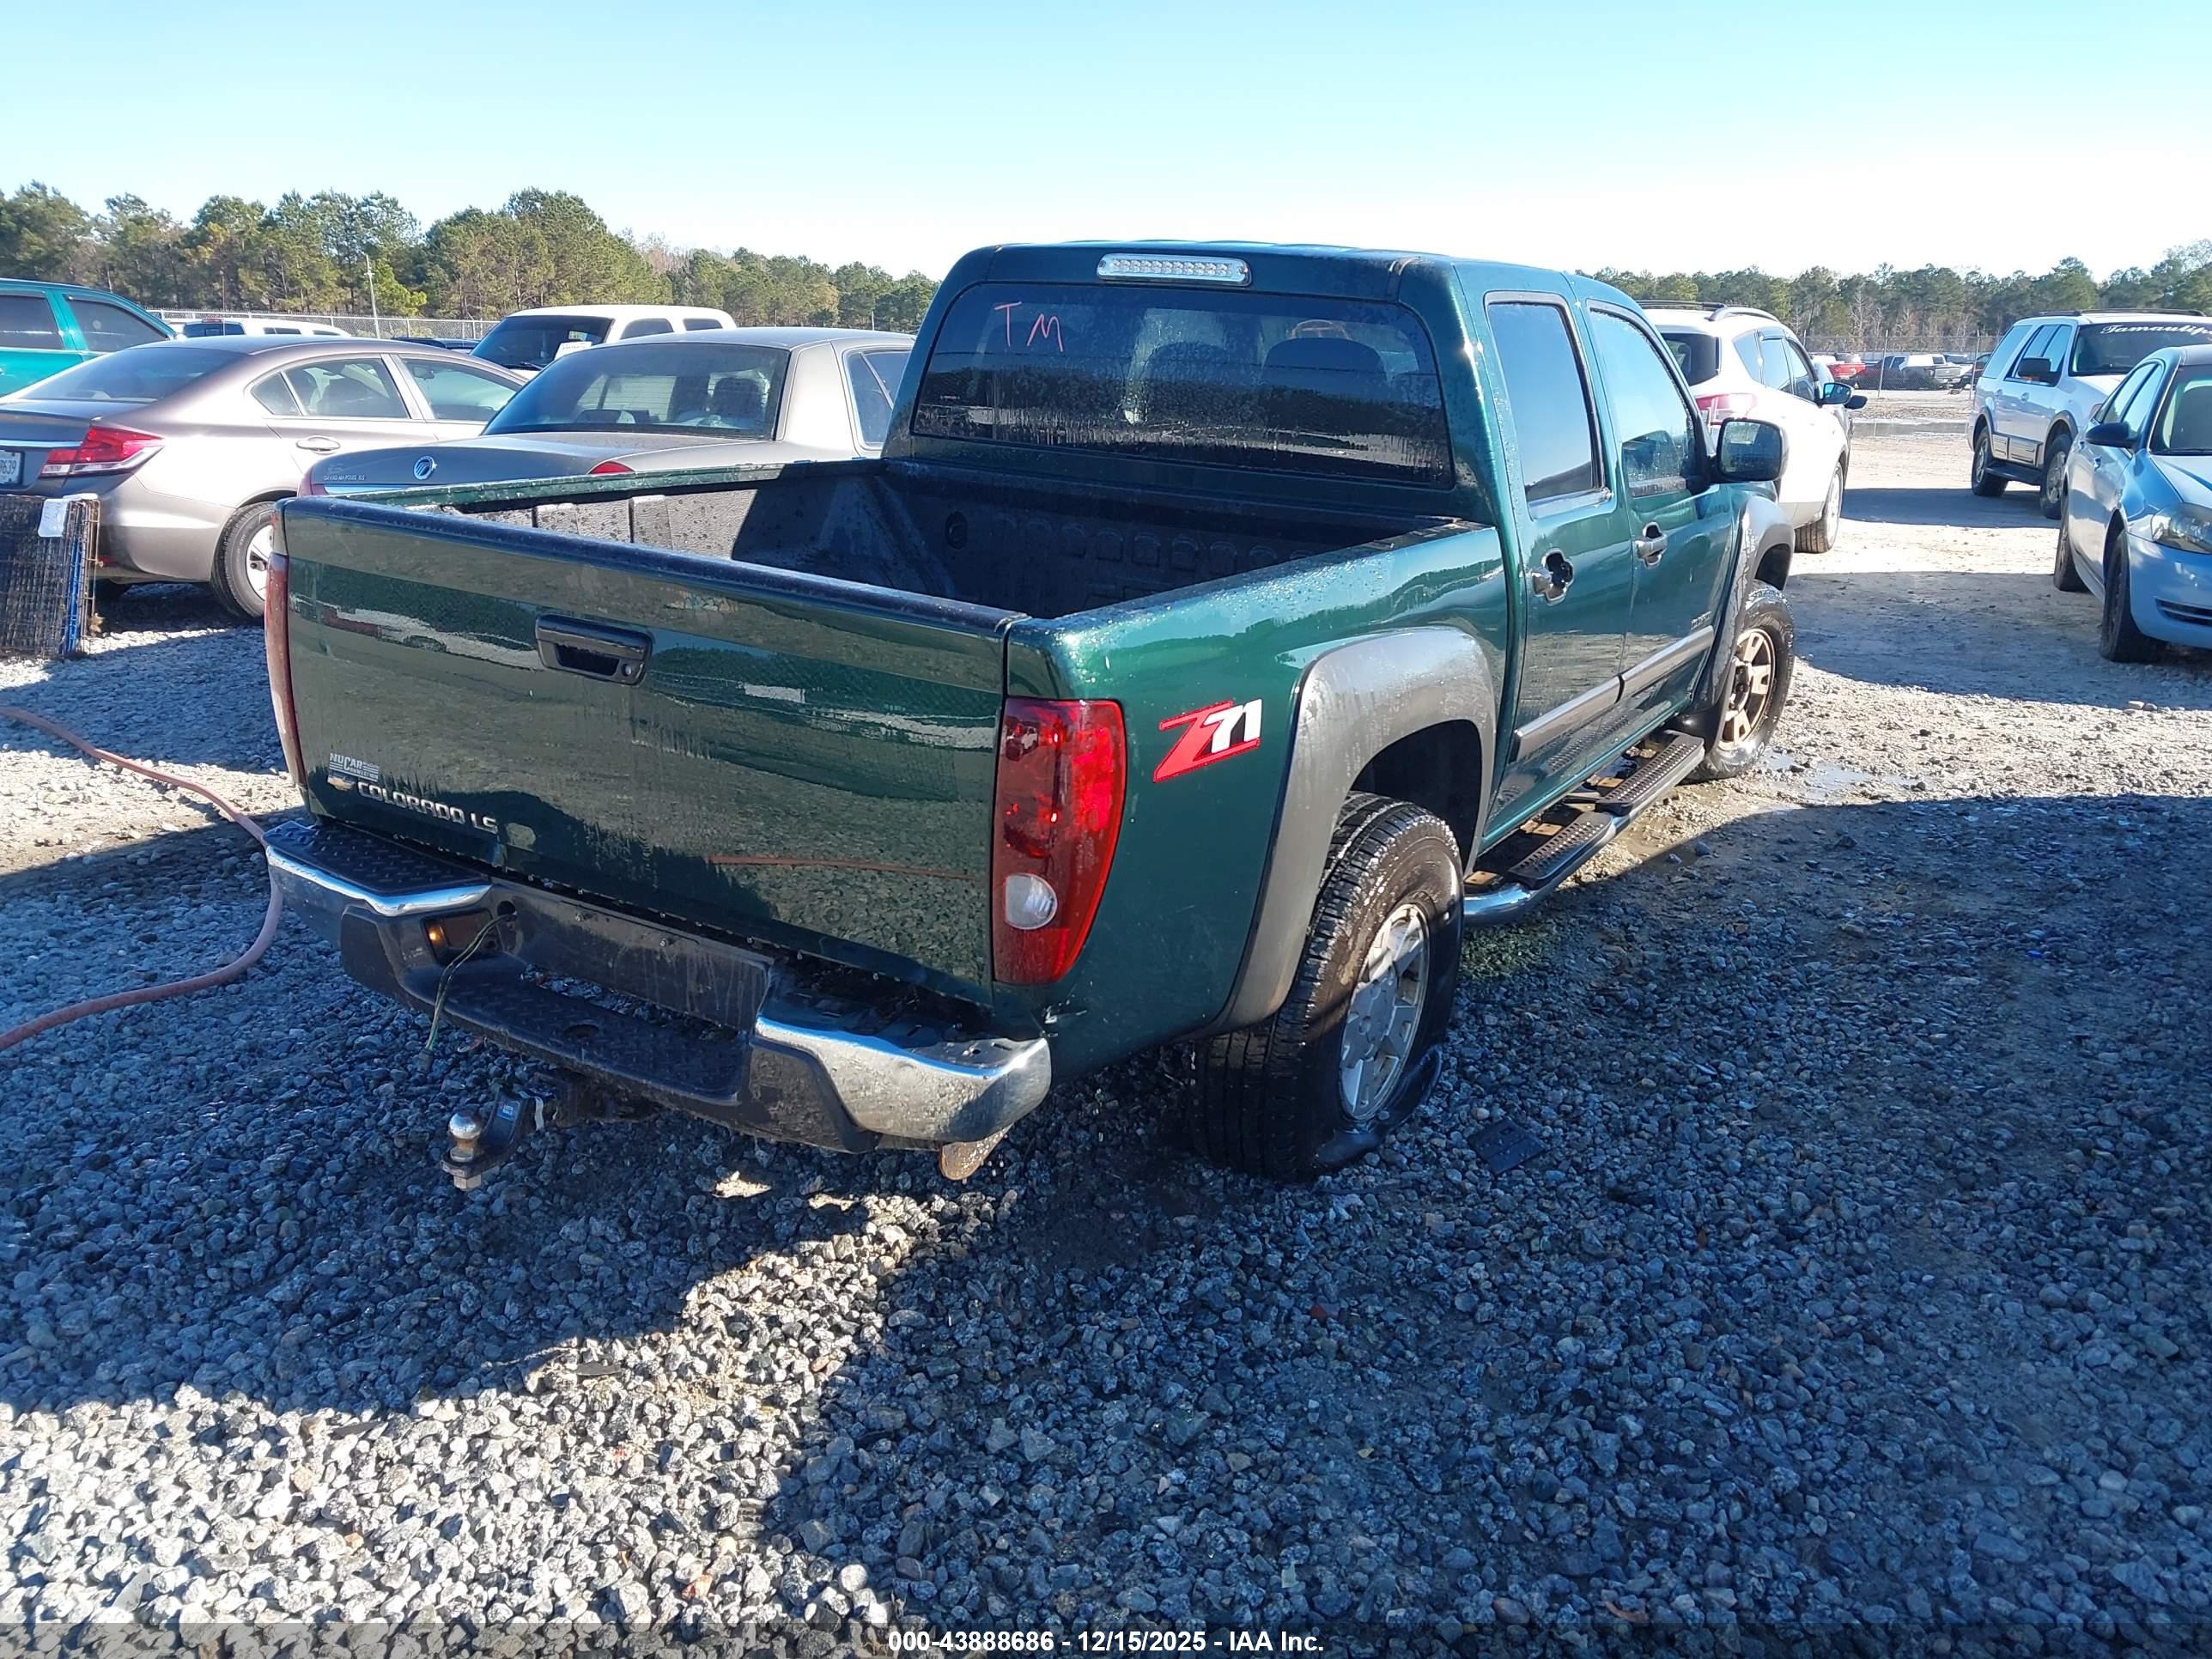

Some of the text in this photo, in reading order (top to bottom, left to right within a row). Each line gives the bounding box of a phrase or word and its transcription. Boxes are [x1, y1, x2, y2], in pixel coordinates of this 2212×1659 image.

[1153, 697, 1262, 782] Z71
[357, 781, 498, 833] COLORADO LS
